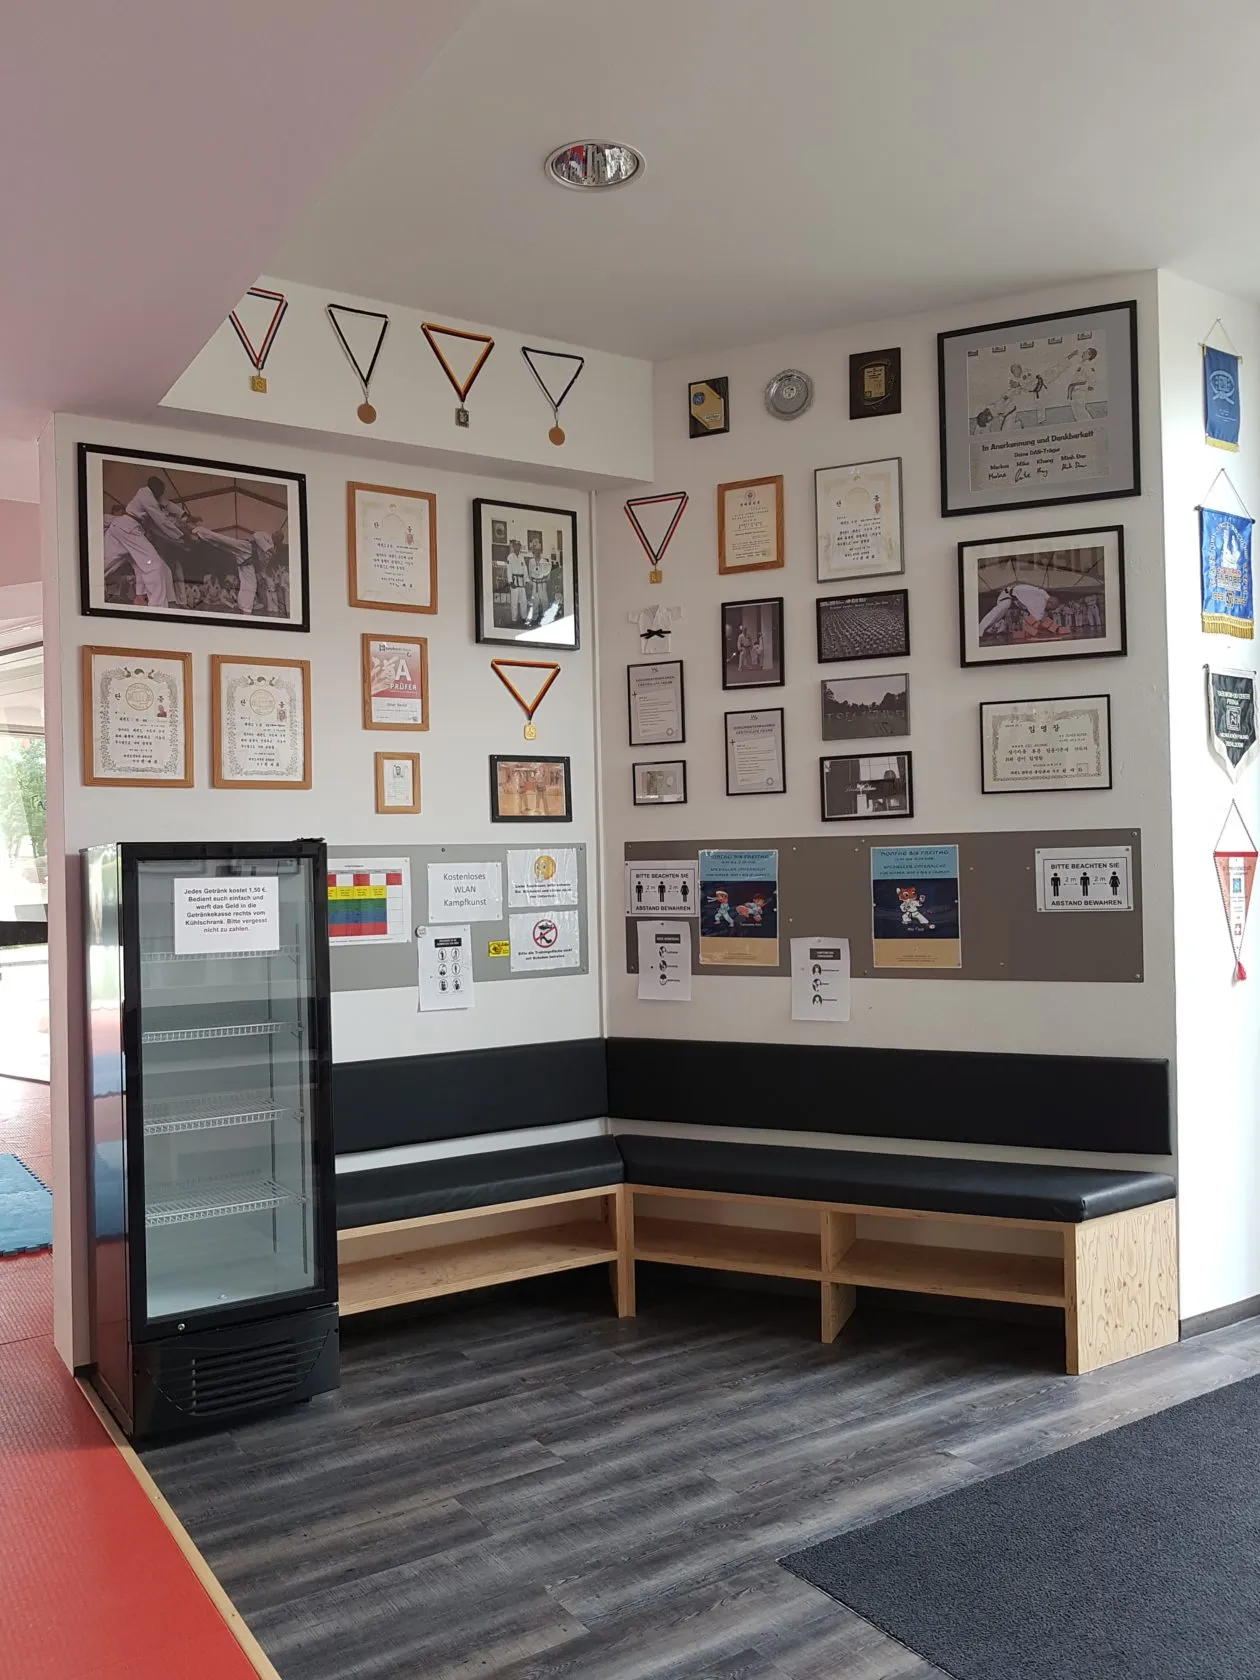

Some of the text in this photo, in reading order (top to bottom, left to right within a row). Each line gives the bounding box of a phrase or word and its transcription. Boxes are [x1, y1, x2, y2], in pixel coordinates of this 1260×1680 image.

[395, 659, 412, 681] A
[443, 872, 486, 880] Kostenloses
[453, 885, 476, 893] WLAN
[443, 898, 487, 907] Kampfkunst
